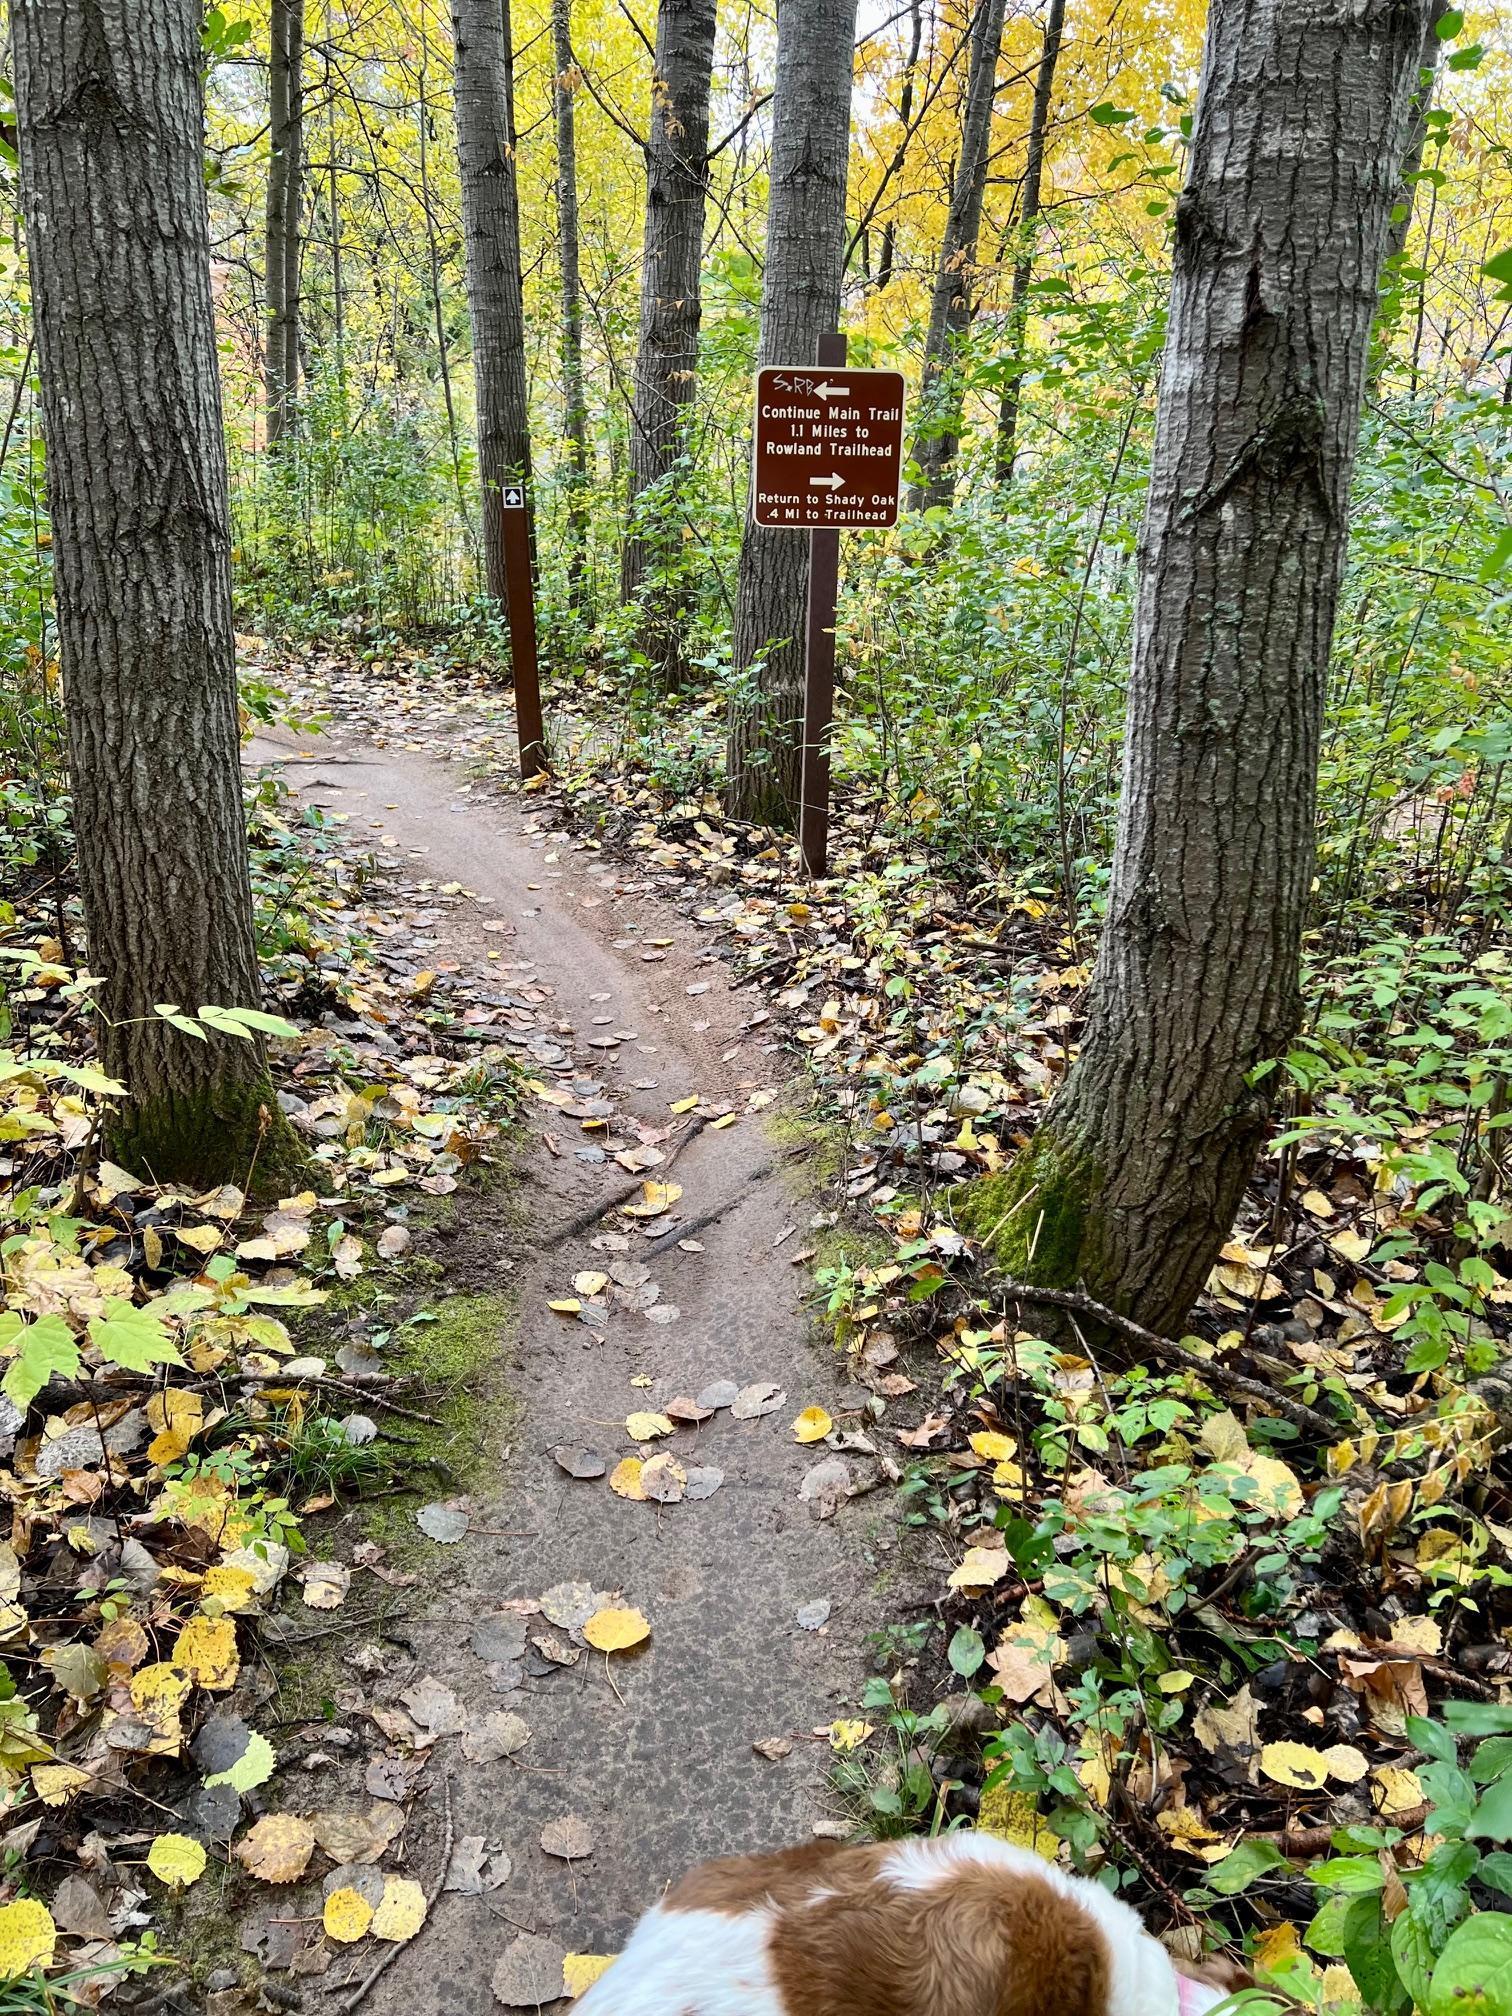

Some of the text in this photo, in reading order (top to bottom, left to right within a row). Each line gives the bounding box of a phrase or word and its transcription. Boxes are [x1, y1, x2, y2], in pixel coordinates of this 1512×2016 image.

[762, 405, 899, 421] Continue Main Trail
[791, 424, 869, 438] 1.1 Miles to
[766, 441, 892, 457] Rowland Trailhead
[759, 493, 895, 507] Return to Shady Oak
[767, 509, 778, 518] .4
[806, 510, 818, 519] to
[826, 510, 887, 520] Trailhead
